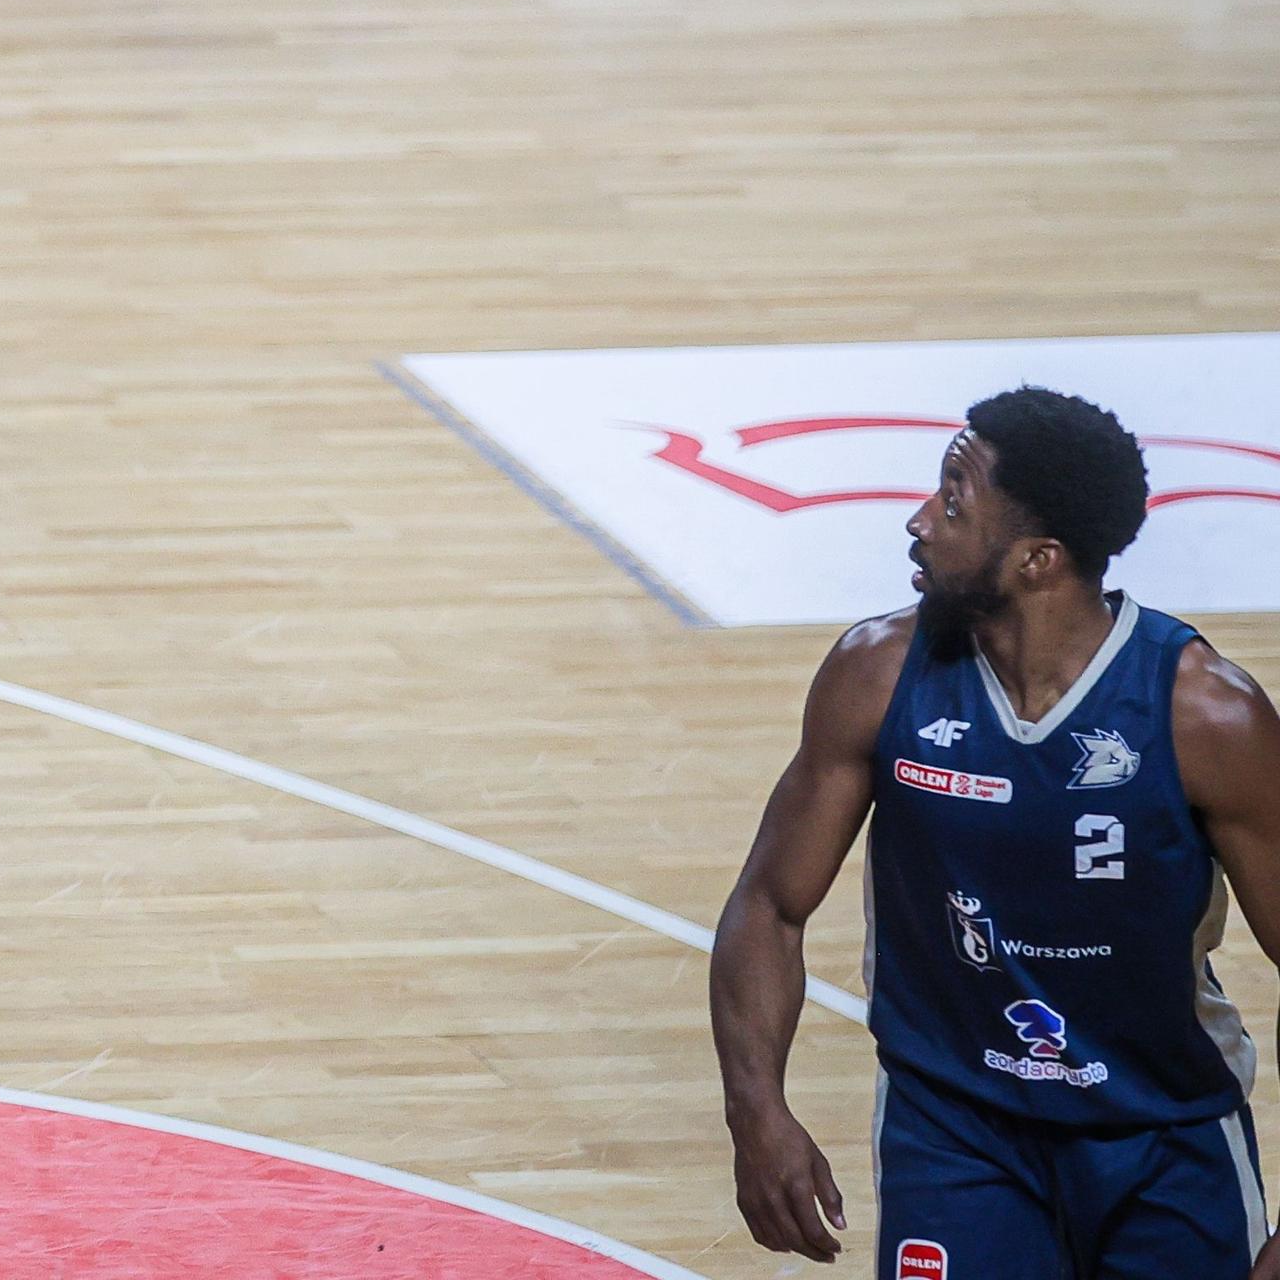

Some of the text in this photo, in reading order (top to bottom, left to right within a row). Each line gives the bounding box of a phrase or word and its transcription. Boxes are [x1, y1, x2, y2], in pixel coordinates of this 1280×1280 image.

[917, 717, 972, 748] 4F
[899, 765, 949, 789] ORLEN
[1073, 813, 1125, 880] 2
[1000, 939, 1112, 960] Warszawa
[903, 1257, 941, 1270] ORLEN
